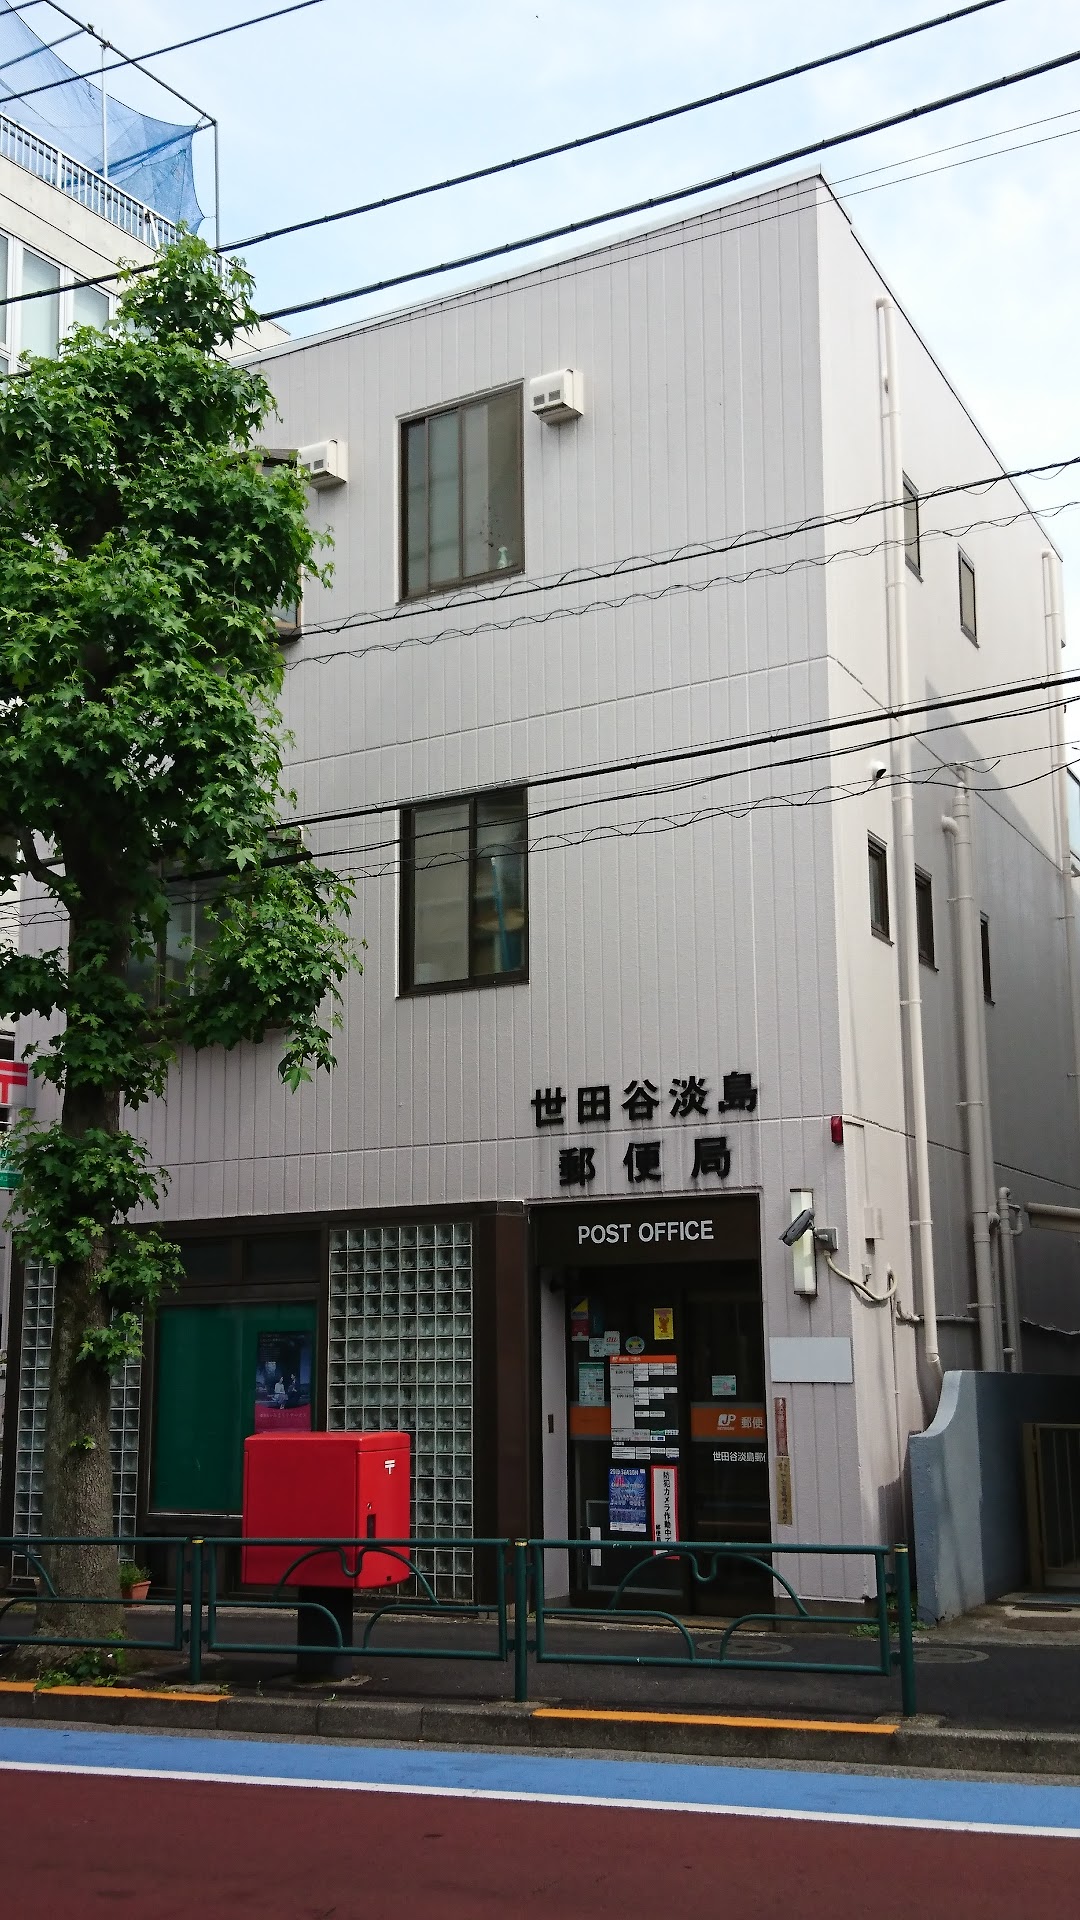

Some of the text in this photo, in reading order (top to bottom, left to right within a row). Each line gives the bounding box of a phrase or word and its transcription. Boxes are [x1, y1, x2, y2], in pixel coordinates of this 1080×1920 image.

[531, 1071, 758, 1128] 世田谷淡島
[558, 1136, 731, 1186] 郵便局
[577, 1219, 715, 1245] POST OFFICE
